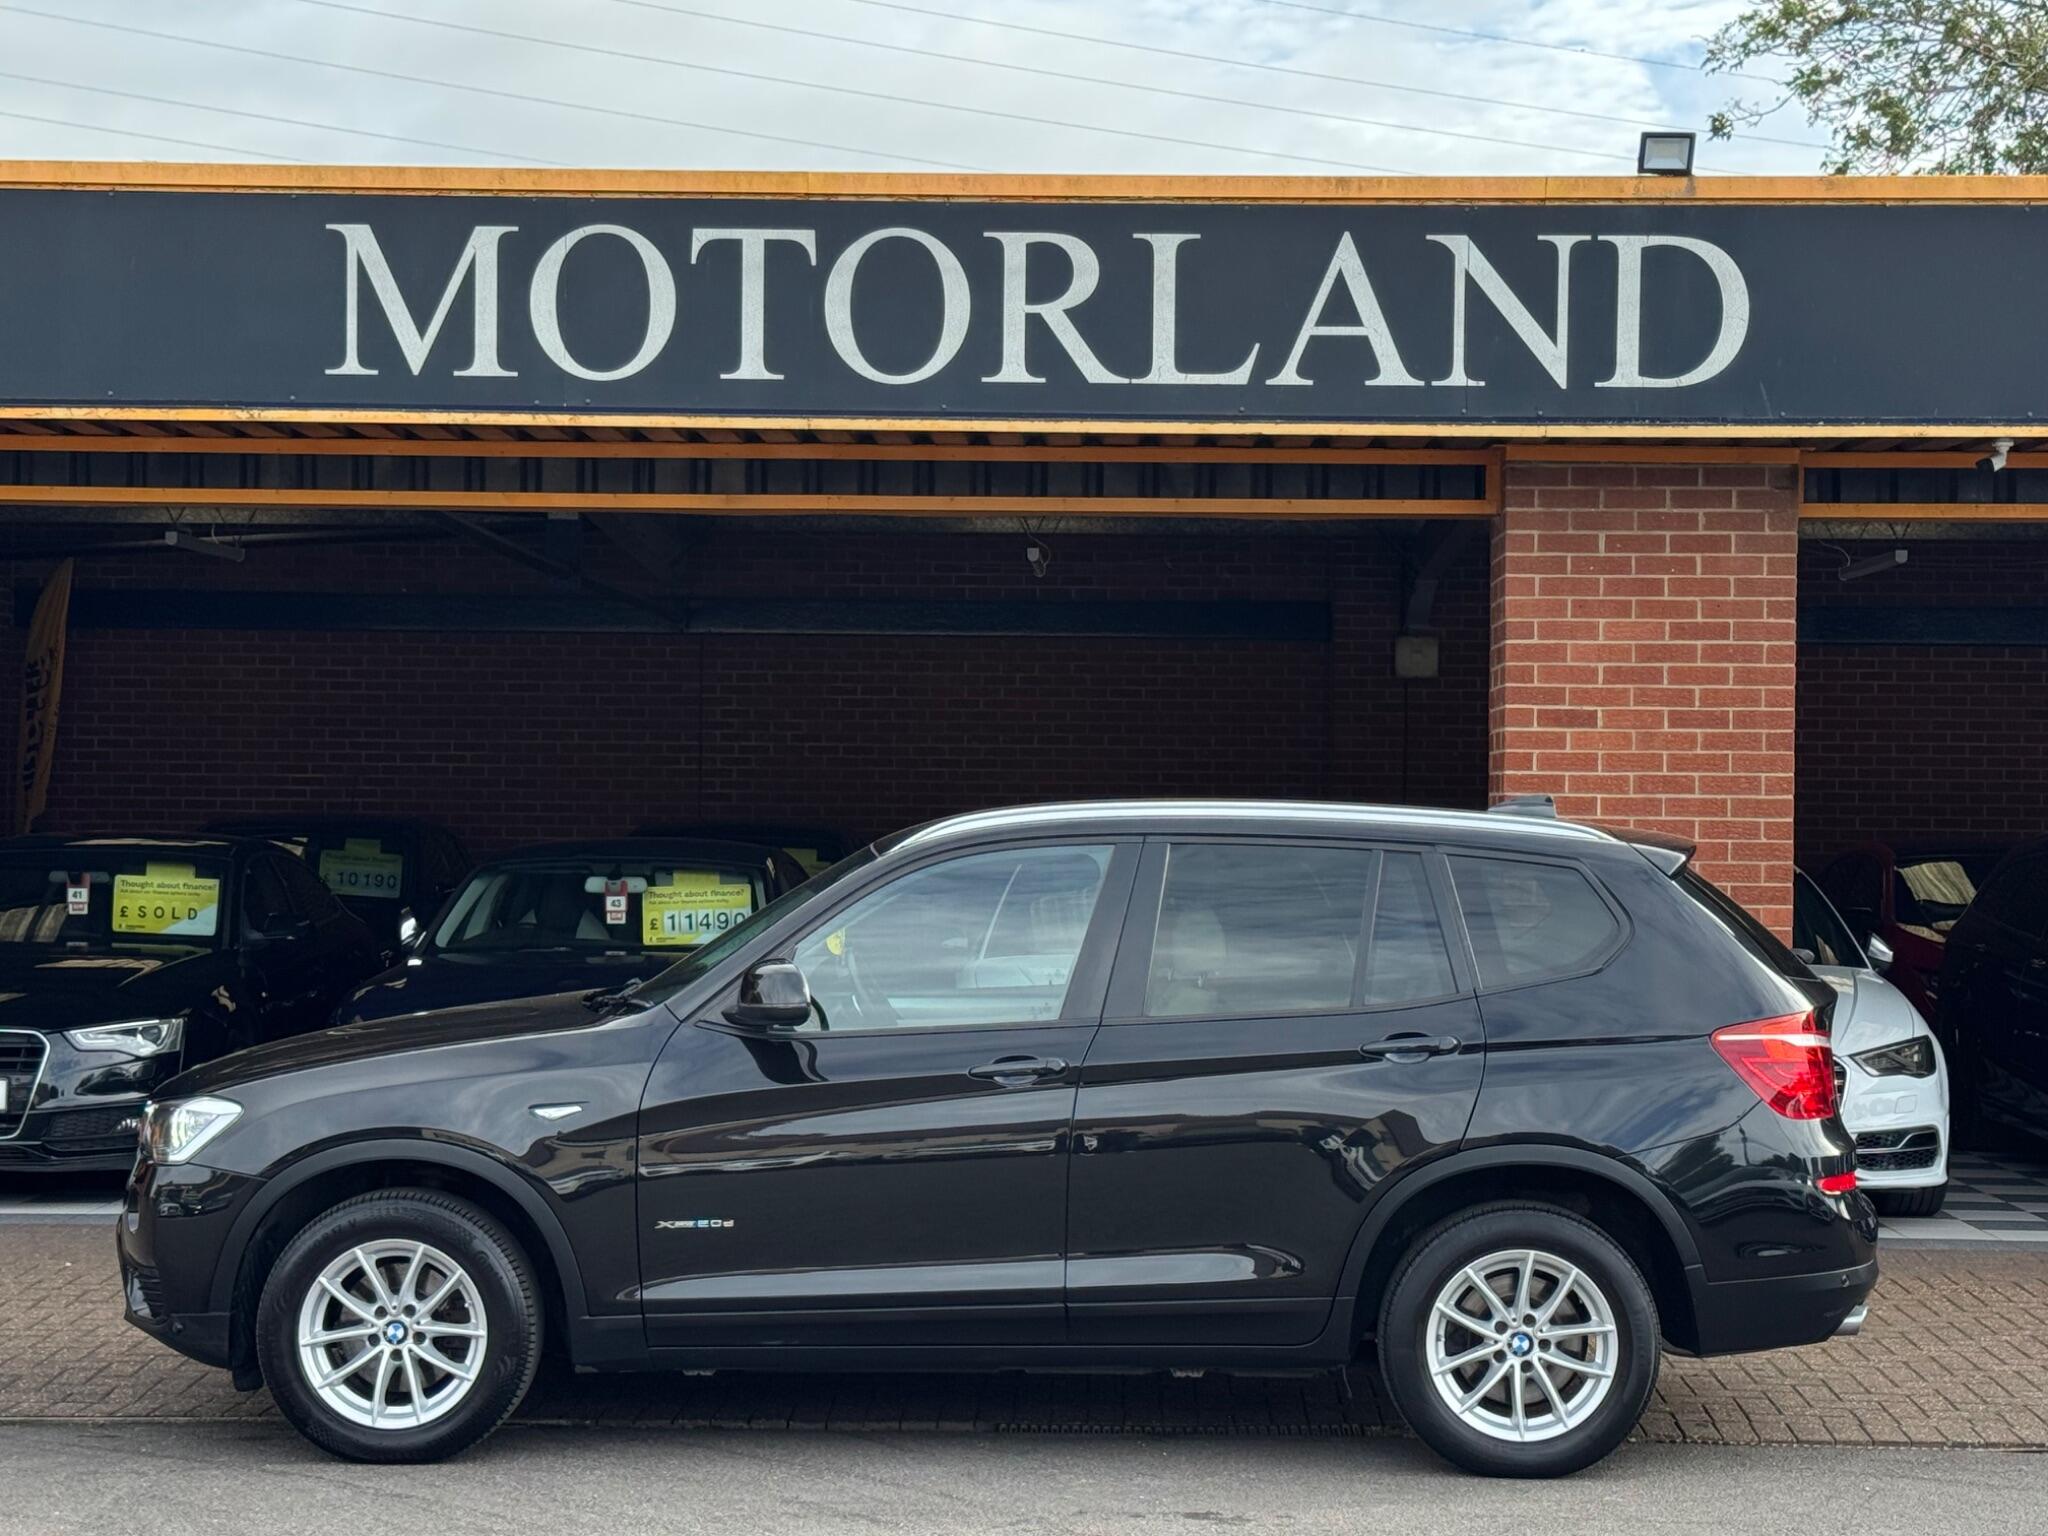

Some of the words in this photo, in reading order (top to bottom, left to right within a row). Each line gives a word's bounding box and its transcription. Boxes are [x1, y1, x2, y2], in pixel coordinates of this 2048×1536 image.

[325, 223, 1751, 389] MOTORLAND
[120, 880, 154, 890] Thought
[157, 881, 181, 890] about
[72, 890, 83, 900] 41
[648, 890, 682, 900] Thought
[684, 889, 708, 898] about
[710, 888, 745, 897] finance?
[611, 898, 622, 908] 43
[138, 905, 198, 920] SOLD
[667, 911, 746, 932] 11490
